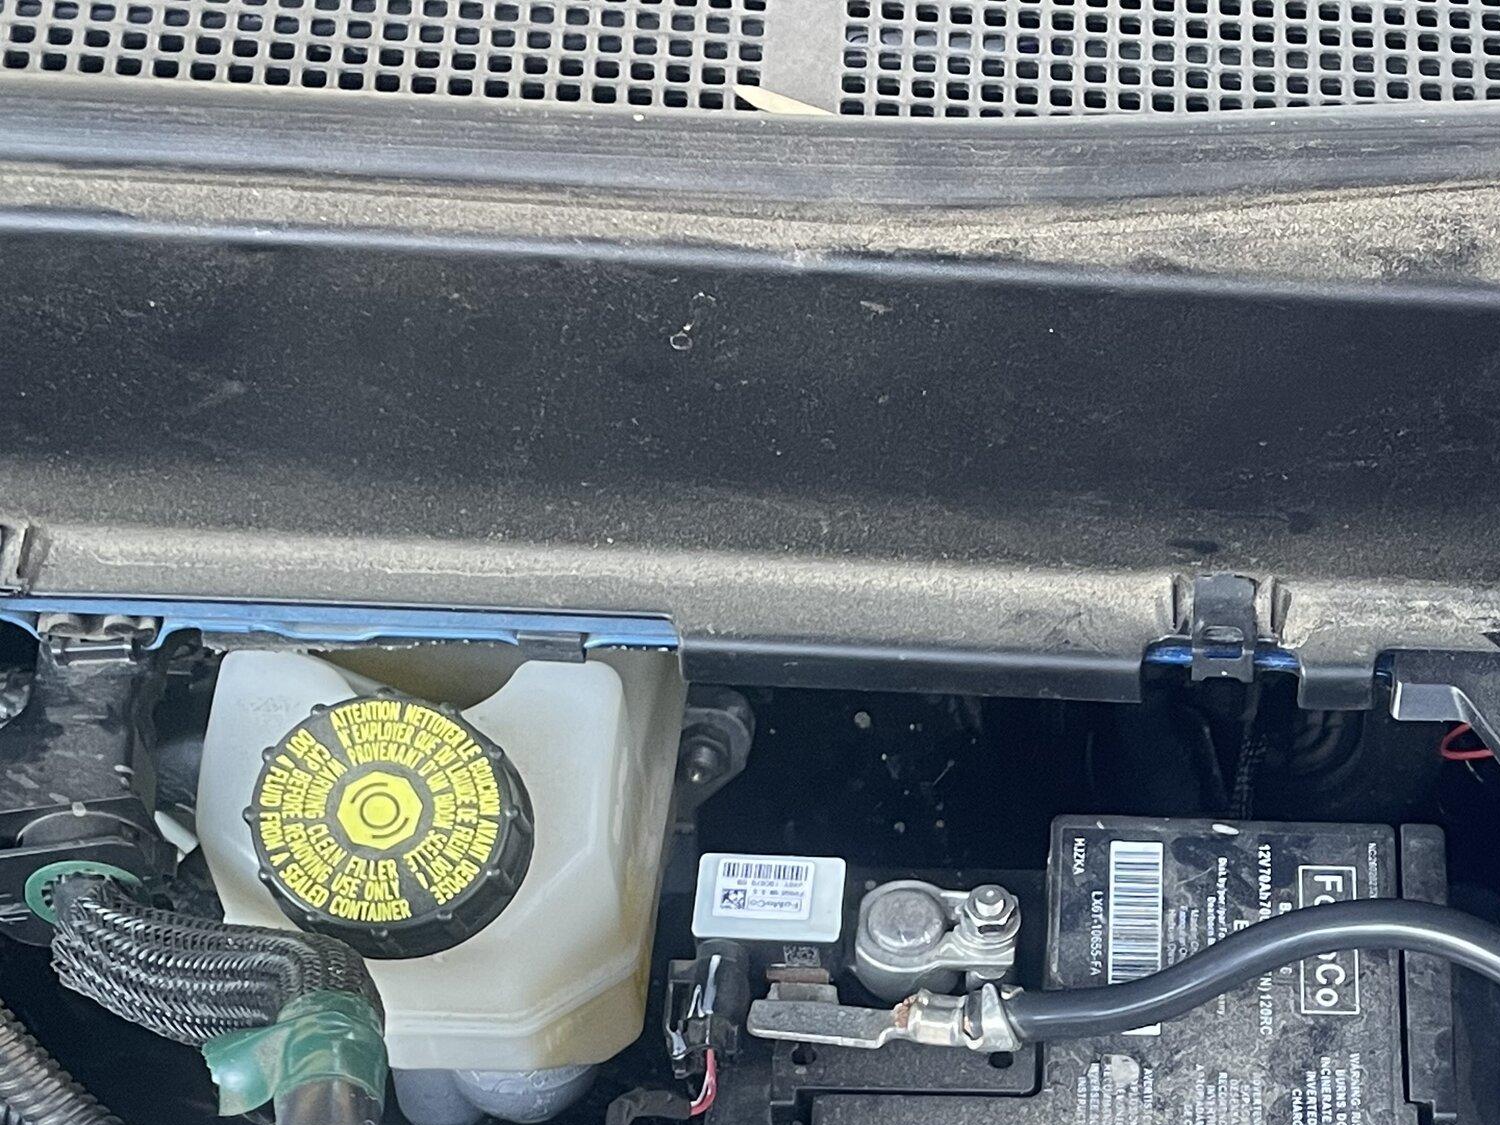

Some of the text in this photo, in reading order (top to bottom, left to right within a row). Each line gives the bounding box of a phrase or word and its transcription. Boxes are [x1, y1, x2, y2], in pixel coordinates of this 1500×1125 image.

[286, 728, 315, 759] DOT
[416, 730, 440, 755] QUE
[433, 747, 454, 769] DU
[259, 766, 290, 807] FLUID
[330, 701, 500, 905] ATTENTION NETTOYER LE BOUCHON AVANT DEPOSE
[282, 744, 401, 900] CAP BEFORE REMOVING USE ONLY
[303, 763, 399, 881] WARNING CLEAN FILLER
[347, 743, 424, 766] PROVENANT
[403, 830, 447, 872] SCELLE
[455, 808, 477, 824] DE
[259, 812, 284, 851] FROM
[446, 825, 474, 860] FREIN
[270, 852, 290, 866] A
[425, 857, 453, 880] DOT
[1073, 837, 1087, 876] HJZKA
[279, 863, 330, 908] SEALED
[329, 899, 412, 921] CONTAINER
[1259, 995, 1273, 1036] 120RC
